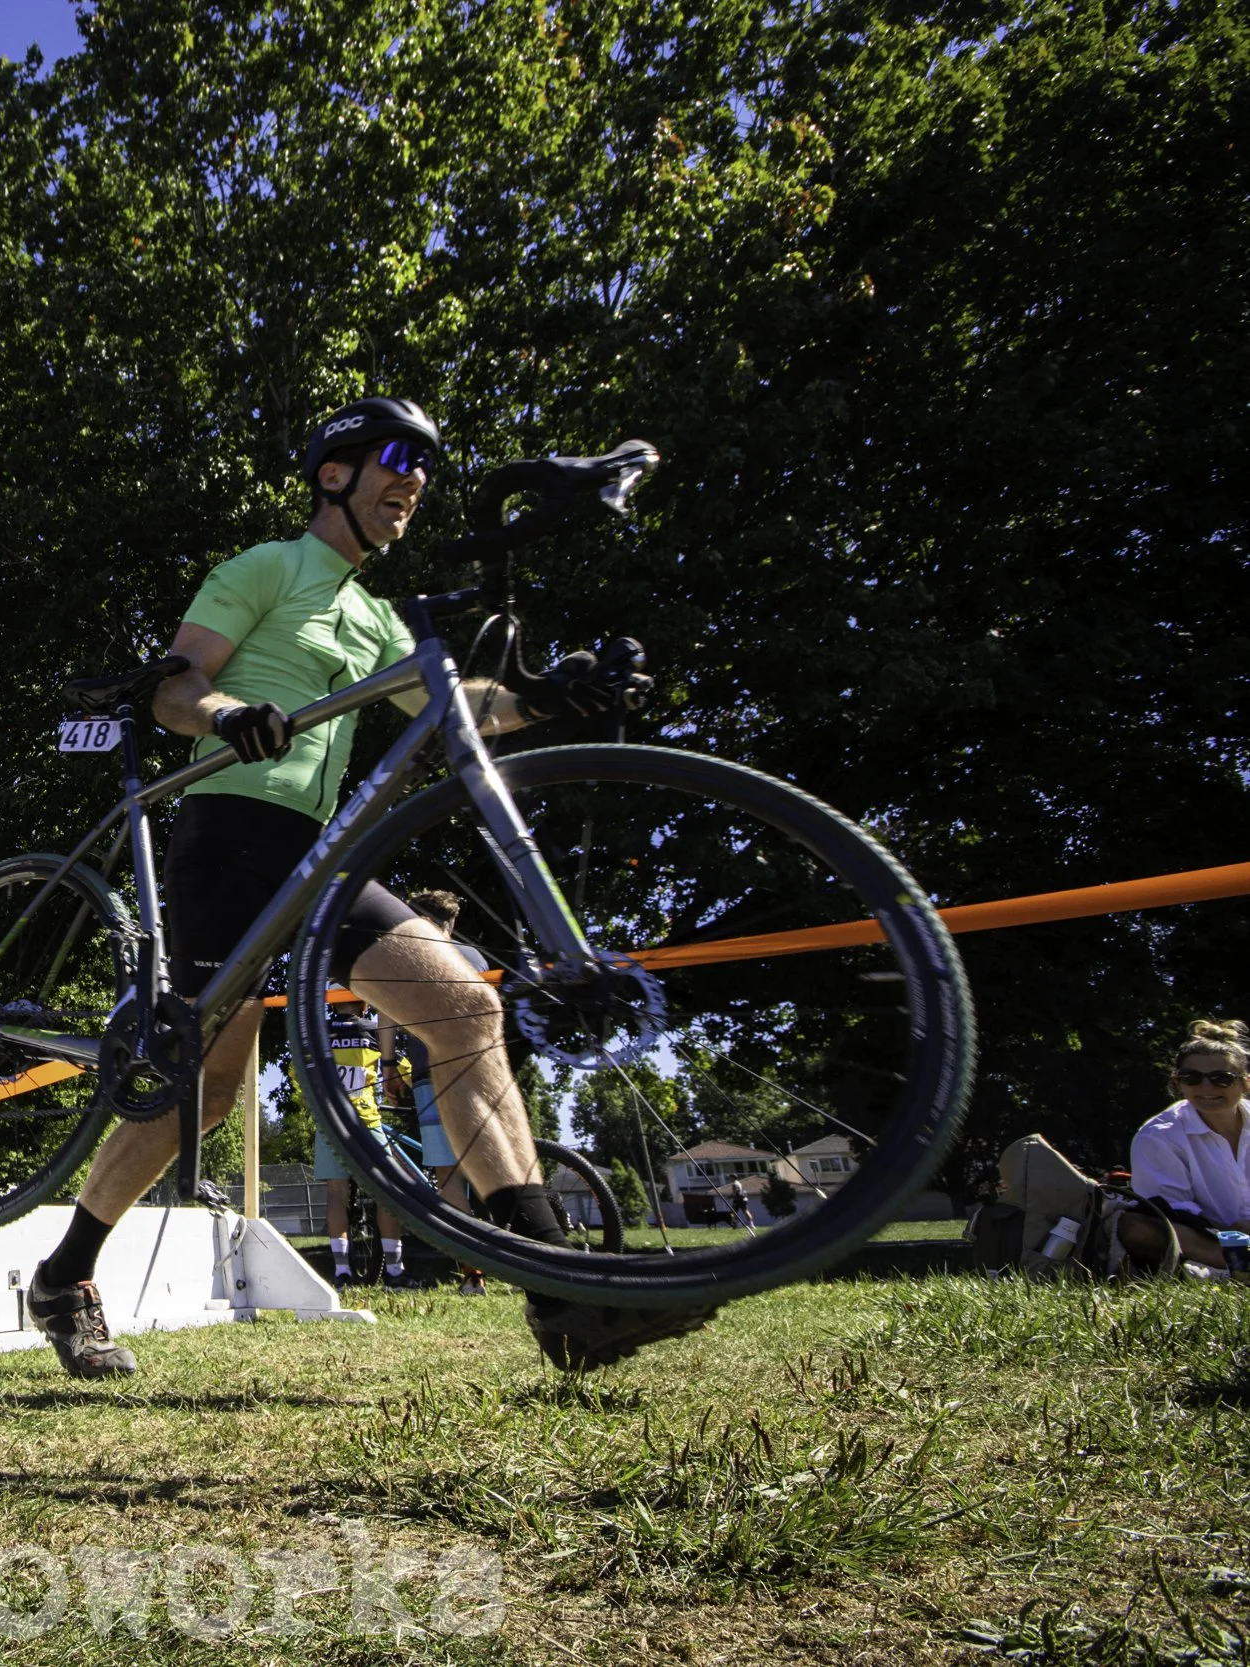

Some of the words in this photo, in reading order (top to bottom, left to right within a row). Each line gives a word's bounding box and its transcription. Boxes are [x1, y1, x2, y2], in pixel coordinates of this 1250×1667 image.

[63, 721, 111, 748] 418
[291, 763, 393, 880] TREK
[330, 1038, 371, 1048] ADER
